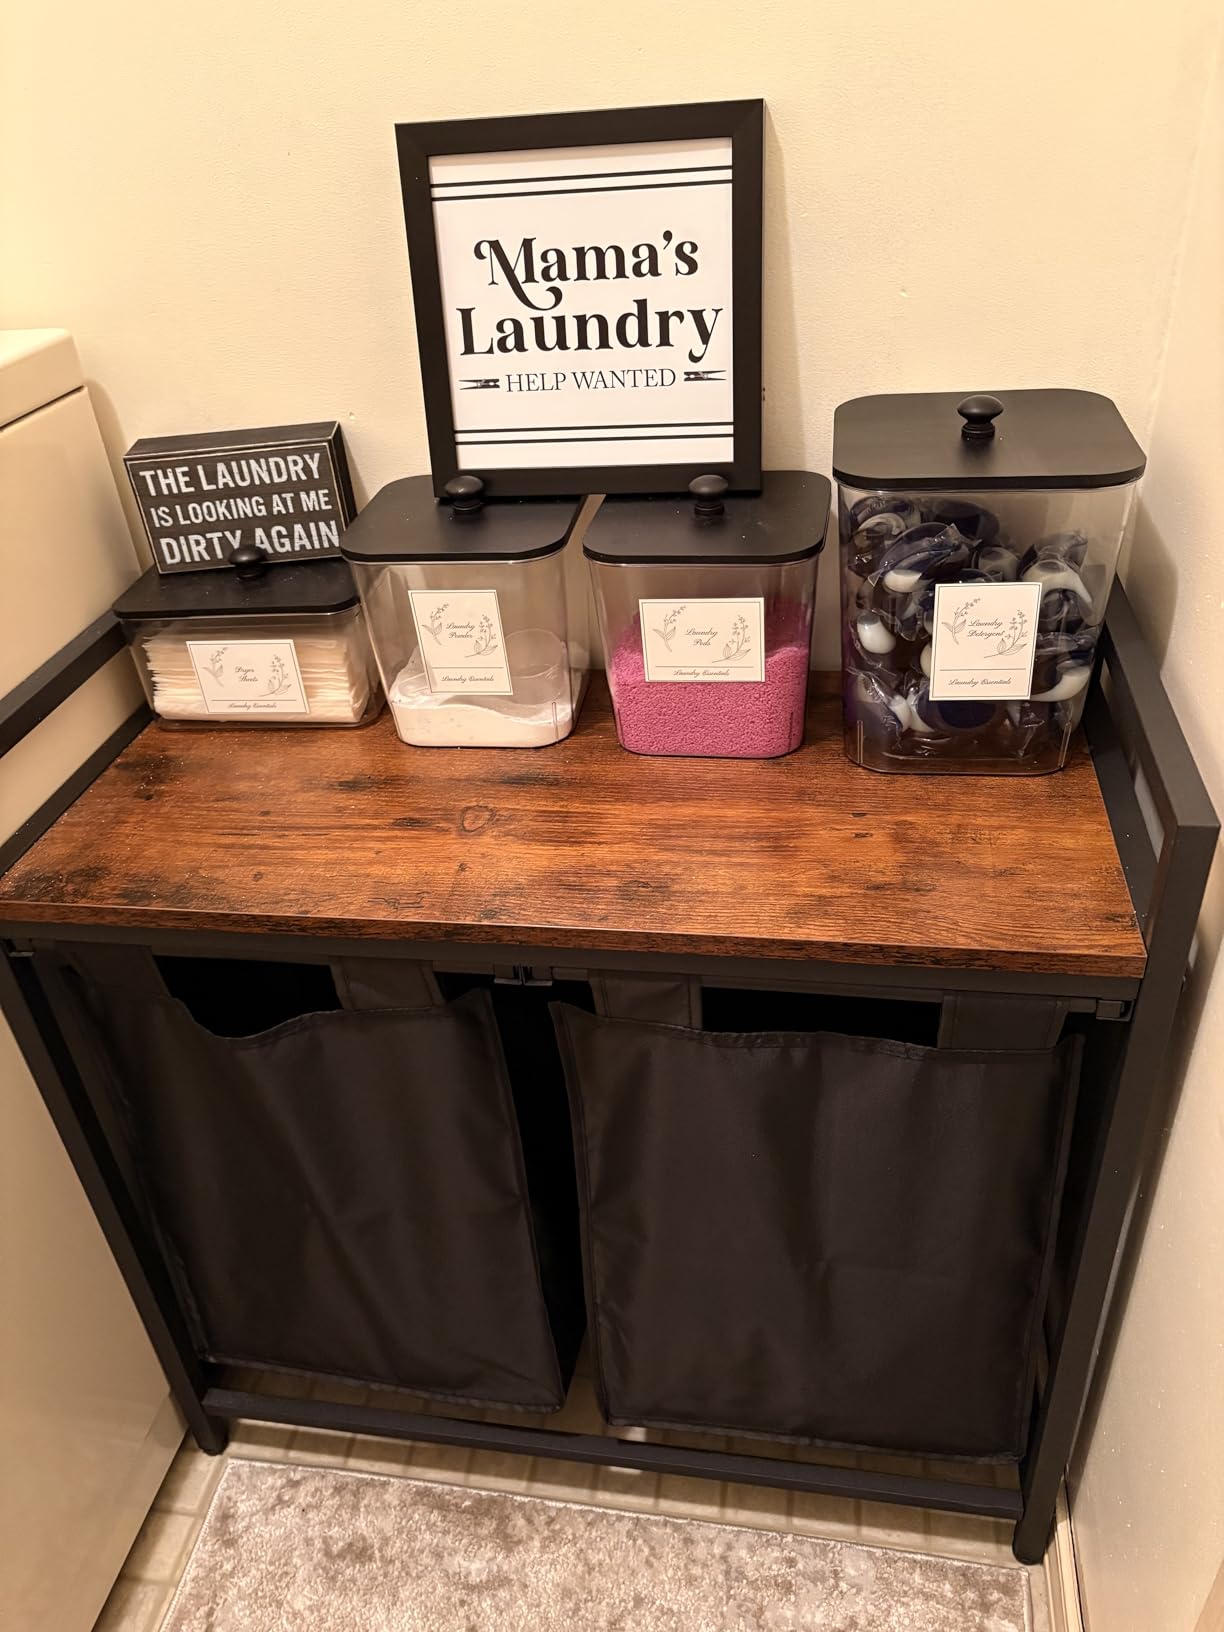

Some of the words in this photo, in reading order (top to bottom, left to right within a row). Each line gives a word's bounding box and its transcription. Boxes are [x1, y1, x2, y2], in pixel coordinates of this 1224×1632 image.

[473, 230, 699, 311] Mama's
[455, 298, 724, 363] Laundry
[505, 372, 567, 393] HELP
[571, 368, 677, 390] WANTED
[139, 466, 195, 497] THE
[197, 452, 321, 492] LAUNDRY
[150, 506, 174, 528] IS
[175, 495, 267, 525] LOOKING
[272, 492, 295, 516] AT
[299, 489, 332, 513] ME
[159, 529, 243, 565] DIRTY
[254, 520, 340, 554] AGAIN
[446, 622, 475, 632] Laundry
[685, 627, 718, 639] Laundry
[967, 629, 1006, 640] Detergent
[968, 618, 1003, 629] Laundry
